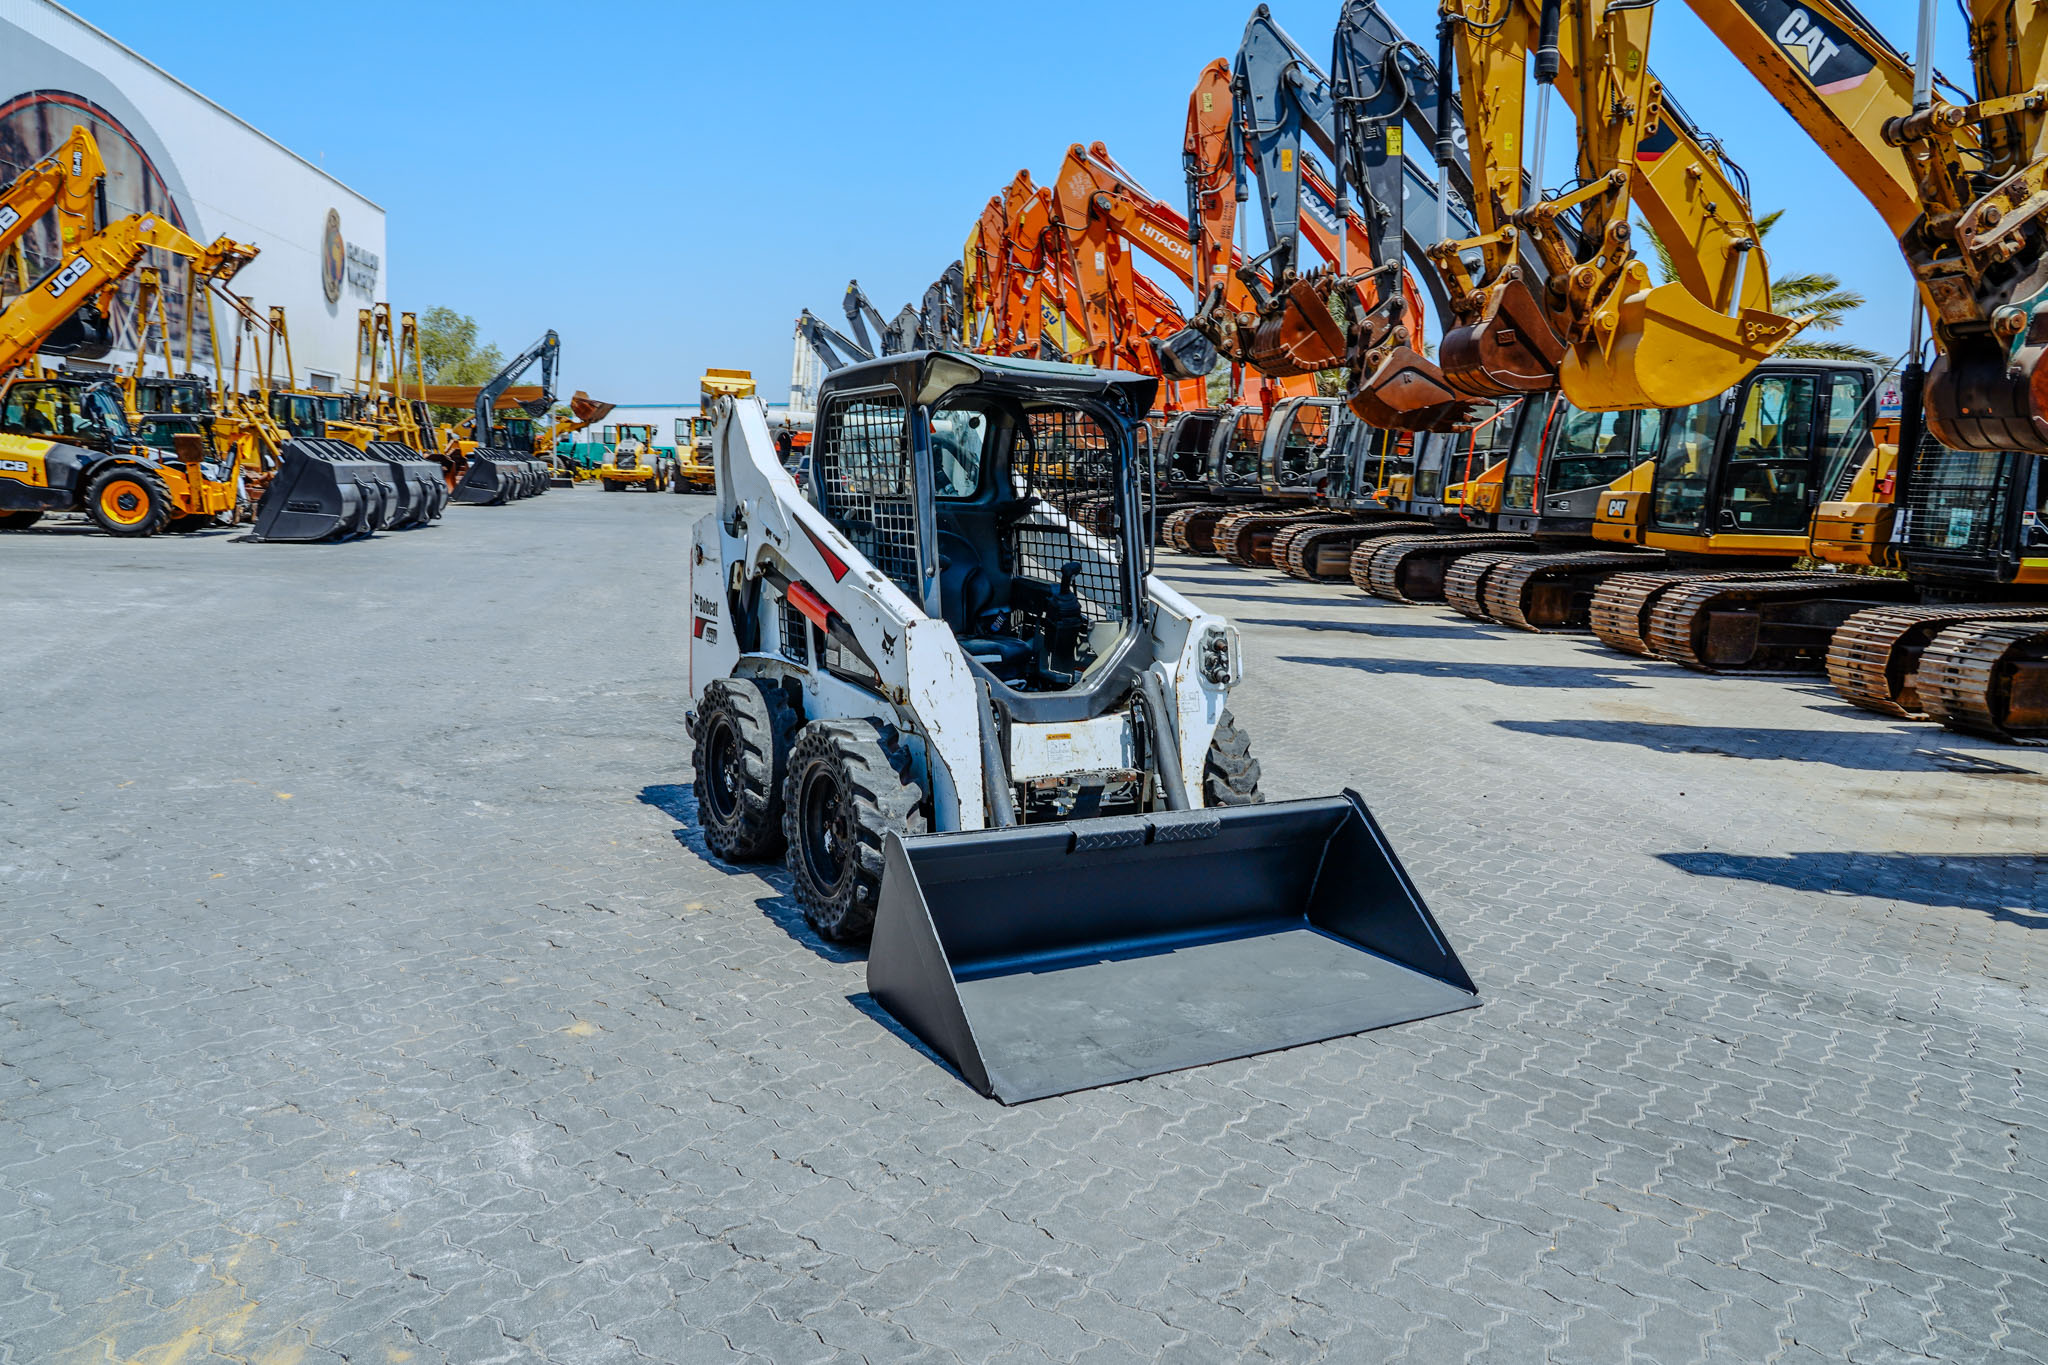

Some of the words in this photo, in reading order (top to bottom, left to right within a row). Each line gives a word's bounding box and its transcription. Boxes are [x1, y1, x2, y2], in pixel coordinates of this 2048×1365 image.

[1776, 8, 1840, 77] CAT
[1140, 222, 1191, 260] HITACHI
[46, 256, 93, 298] JCB
[506, 356, 533, 380] HYUNDAI
[0, 460, 28, 472] CB
[1608, 500, 1627, 517] CAT
[700, 596, 719, 617] Bobcat
